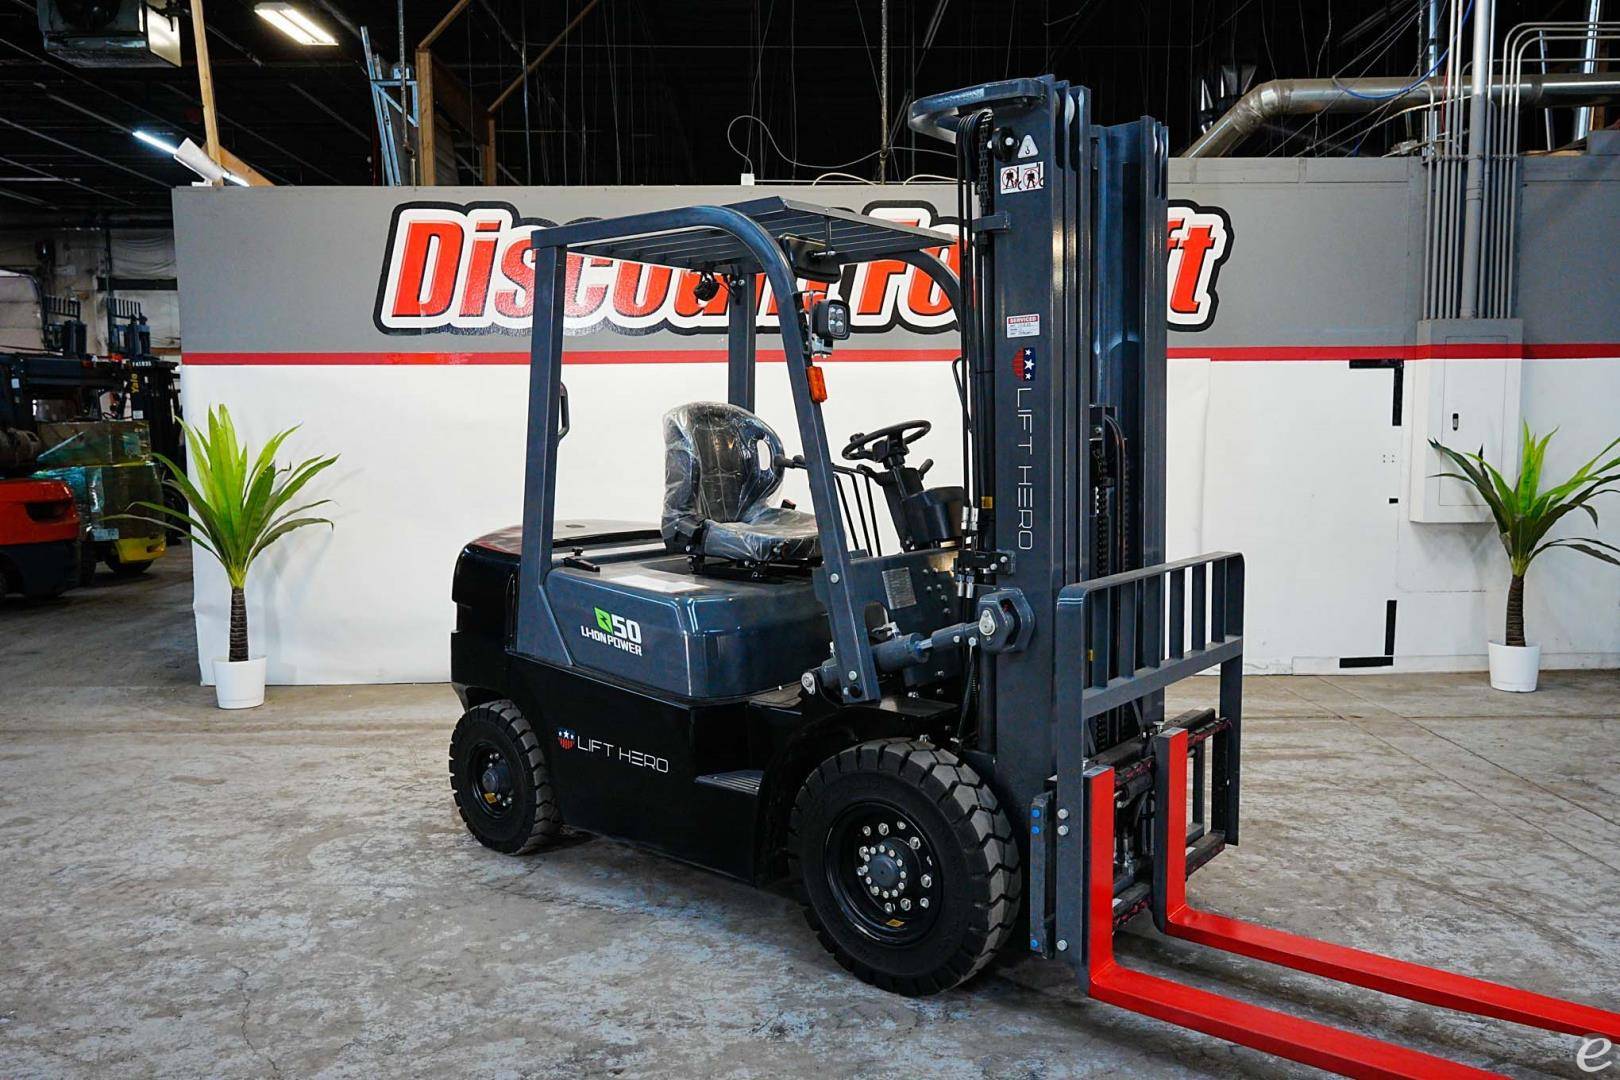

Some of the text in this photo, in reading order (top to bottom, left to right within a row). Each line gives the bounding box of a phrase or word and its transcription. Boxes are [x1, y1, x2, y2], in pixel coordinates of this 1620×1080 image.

[1017, 387, 1033, 550] LIFT HERO
[607, 634, 643, 657] POWER
[611, 613, 642, 644] 50
[577, 735, 669, 773] LIFT HERO
